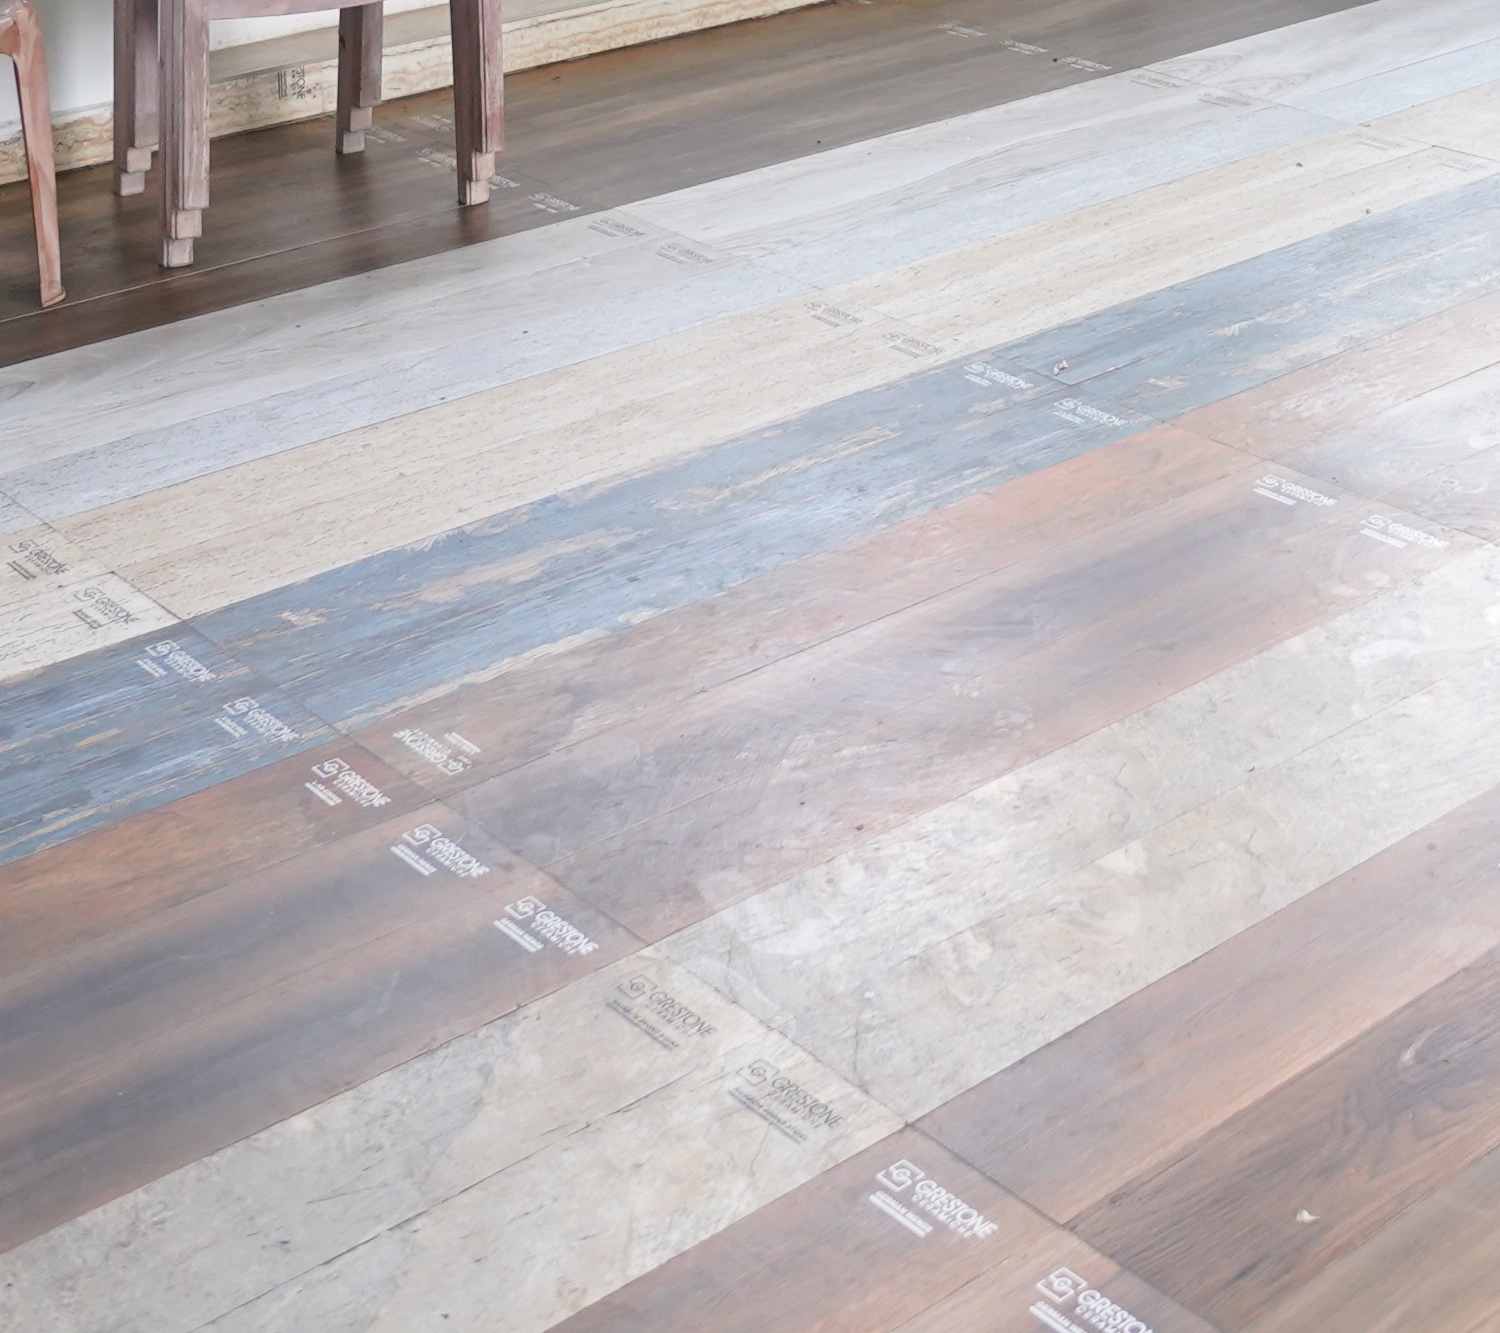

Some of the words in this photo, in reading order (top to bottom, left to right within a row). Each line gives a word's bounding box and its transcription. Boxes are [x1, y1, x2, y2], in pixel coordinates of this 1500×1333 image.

[649, 990, 718, 1039] GRESTONE
[772, 1076, 847, 1130] GRESTONE
[915, 1178, 1000, 1240] GRESTONE
